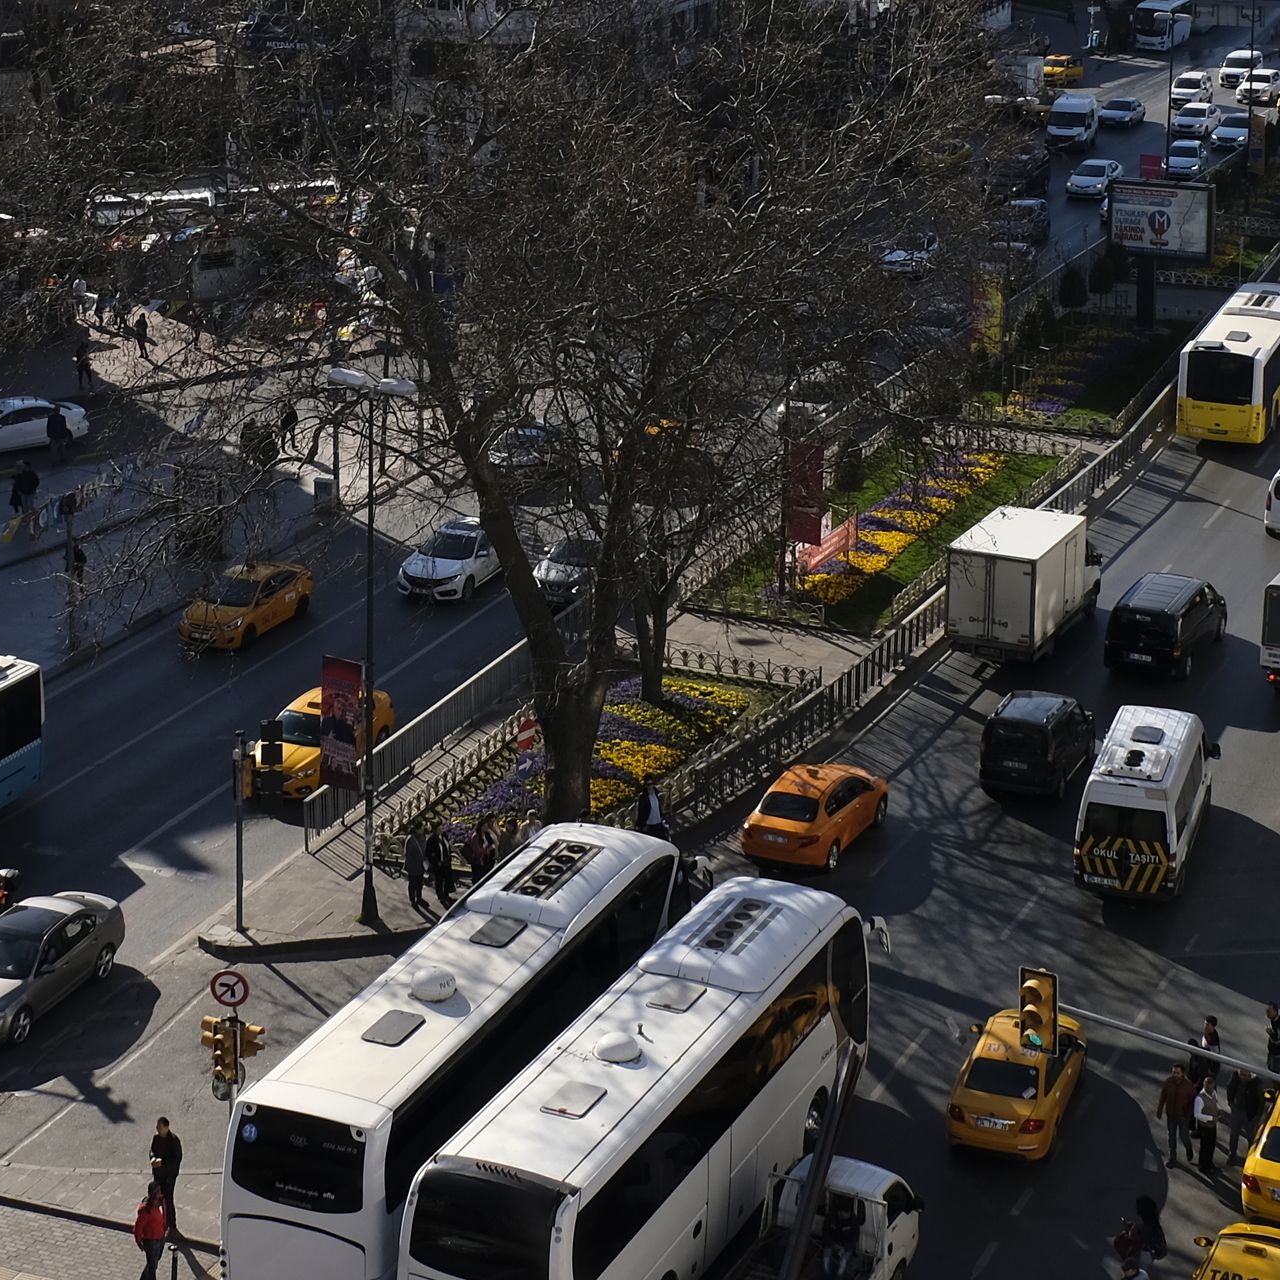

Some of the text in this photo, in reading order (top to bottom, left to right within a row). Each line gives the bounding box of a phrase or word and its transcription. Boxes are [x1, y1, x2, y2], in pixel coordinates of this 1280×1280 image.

[1093, 847, 1159, 865] OKUL TAŞITI
[244, 1125, 256, 1137] 31
